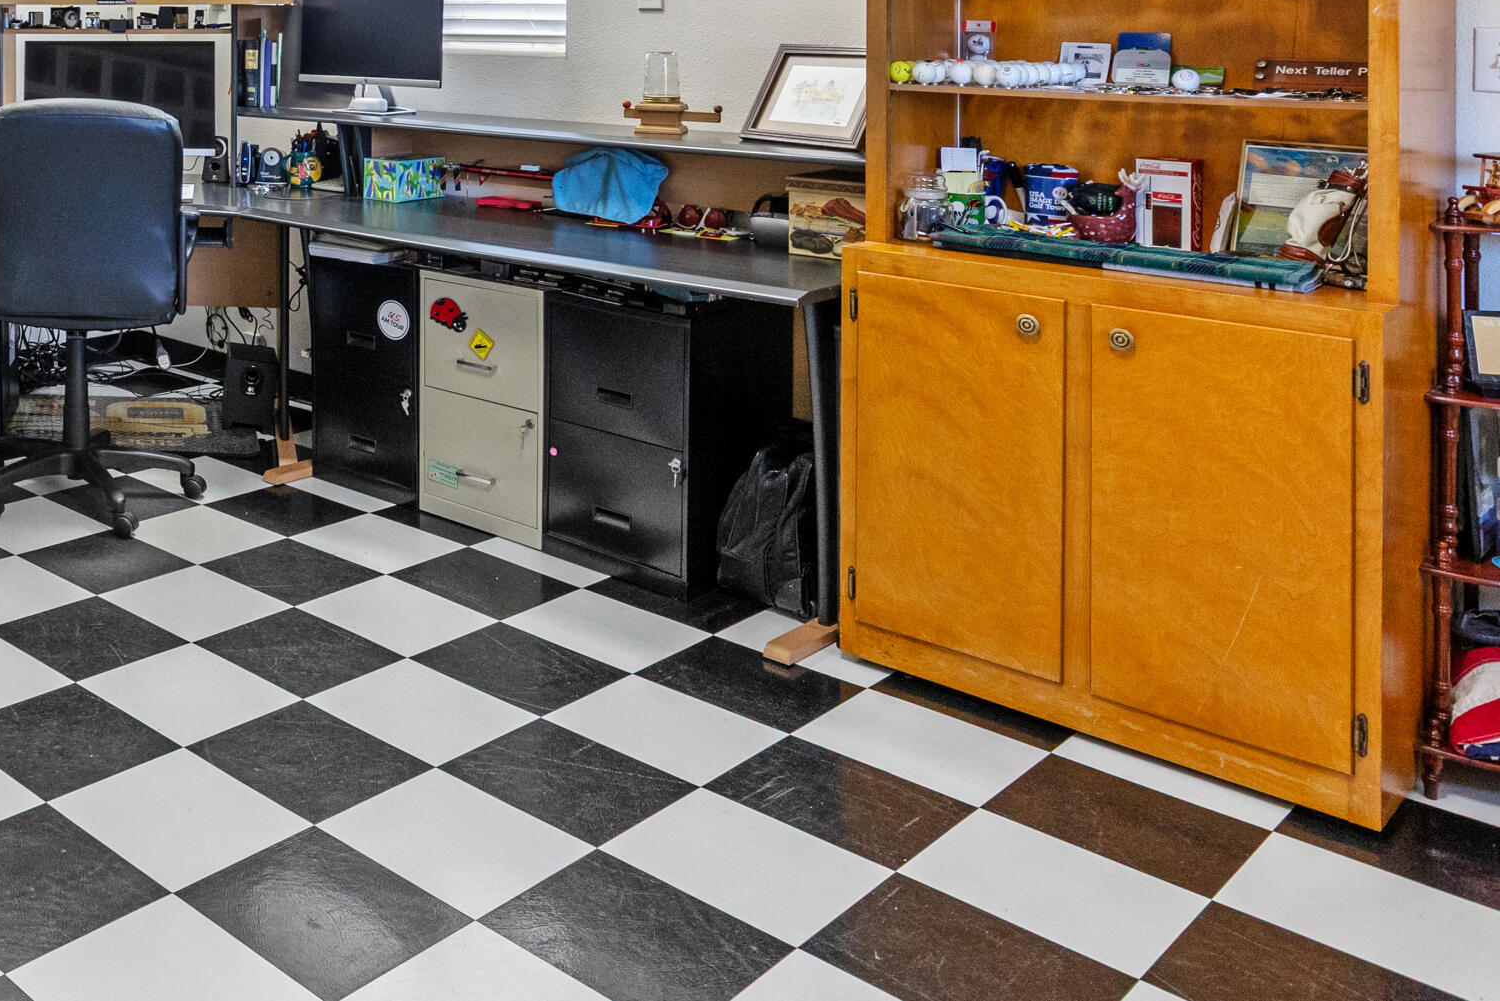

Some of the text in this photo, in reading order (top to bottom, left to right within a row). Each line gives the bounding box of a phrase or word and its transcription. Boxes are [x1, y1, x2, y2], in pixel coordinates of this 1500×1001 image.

[1276, 66, 1368, 76] Next Teller P
[390, 320, 405, 332] TOUR
